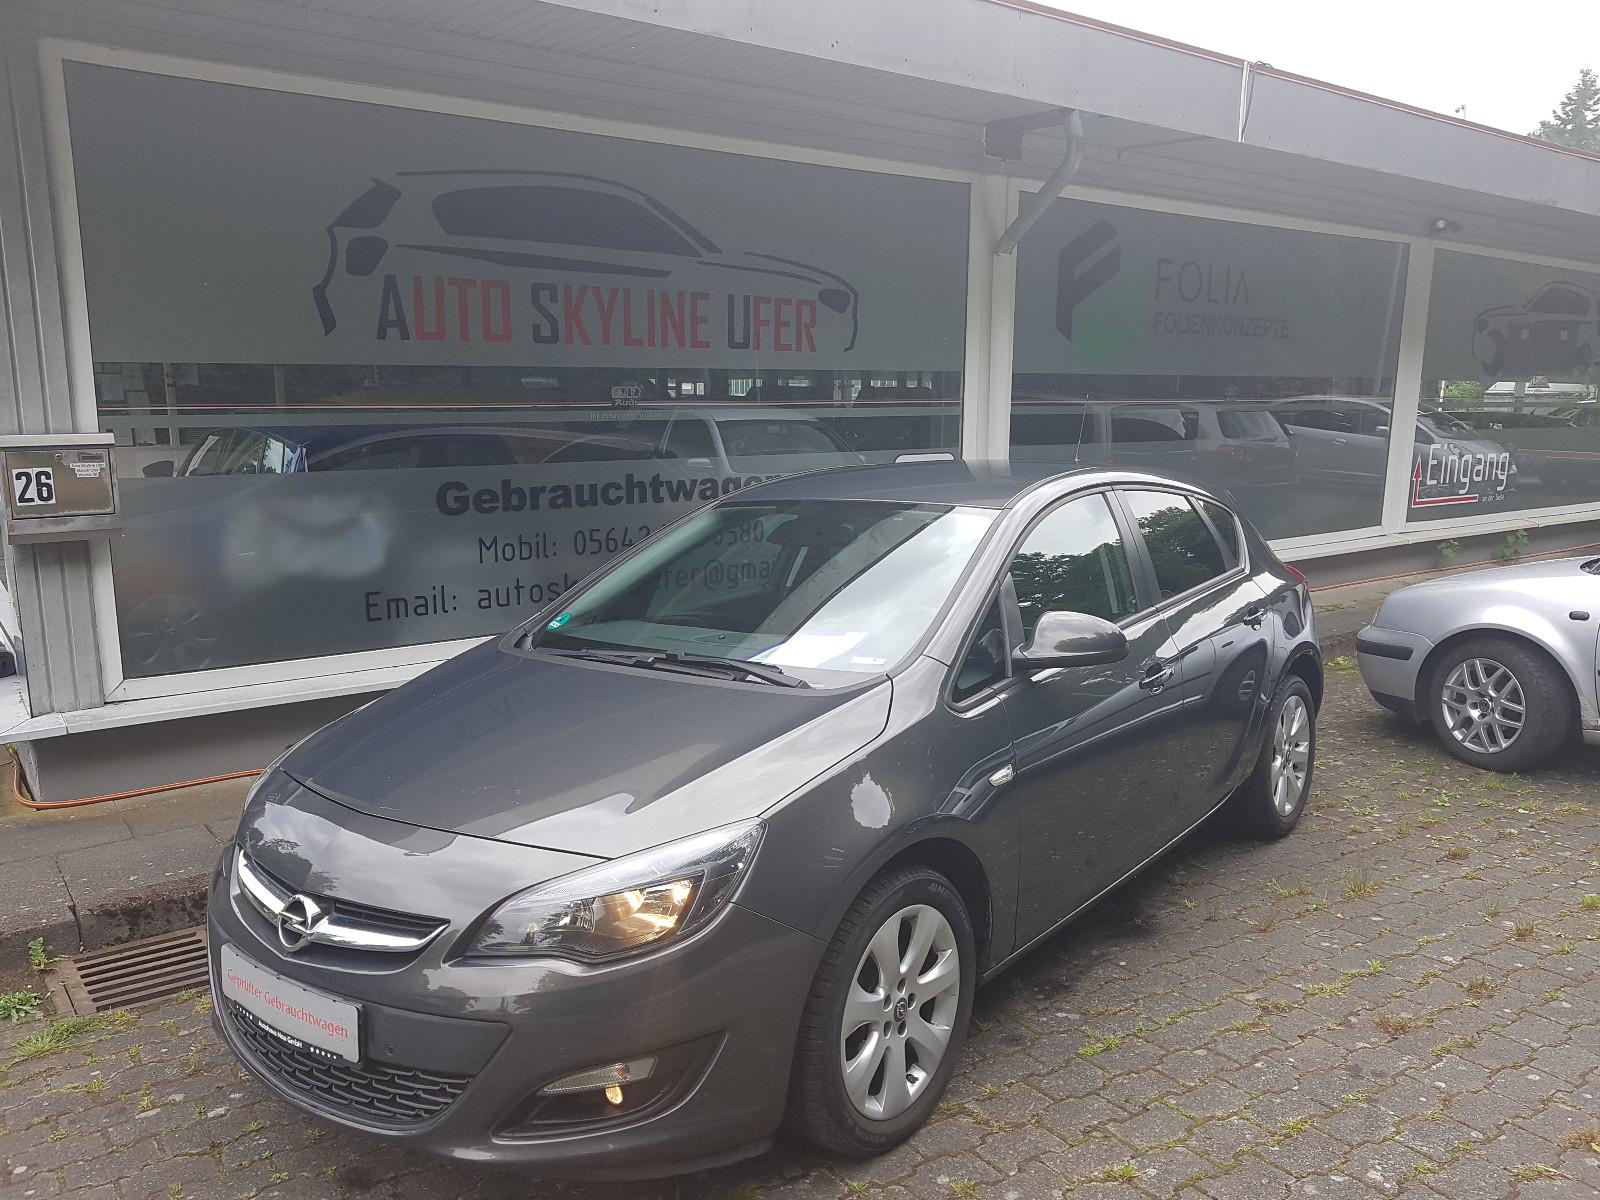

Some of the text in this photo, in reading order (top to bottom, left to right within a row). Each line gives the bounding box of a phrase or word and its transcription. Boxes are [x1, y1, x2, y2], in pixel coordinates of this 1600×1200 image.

[377, 274, 818, 353] AUTO SKYLINE UFER
[1153, 311, 1290, 339] FOLIENKONZEPTE
[15, 470, 54, 504] 26
[1426, 443, 1510, 495] Eingang
[478, 533, 557, 565] Mobil:
[365, 584, 457, 622] Email:
[227, 968, 348, 1038] Geprüfter Gebrauchtwagen
